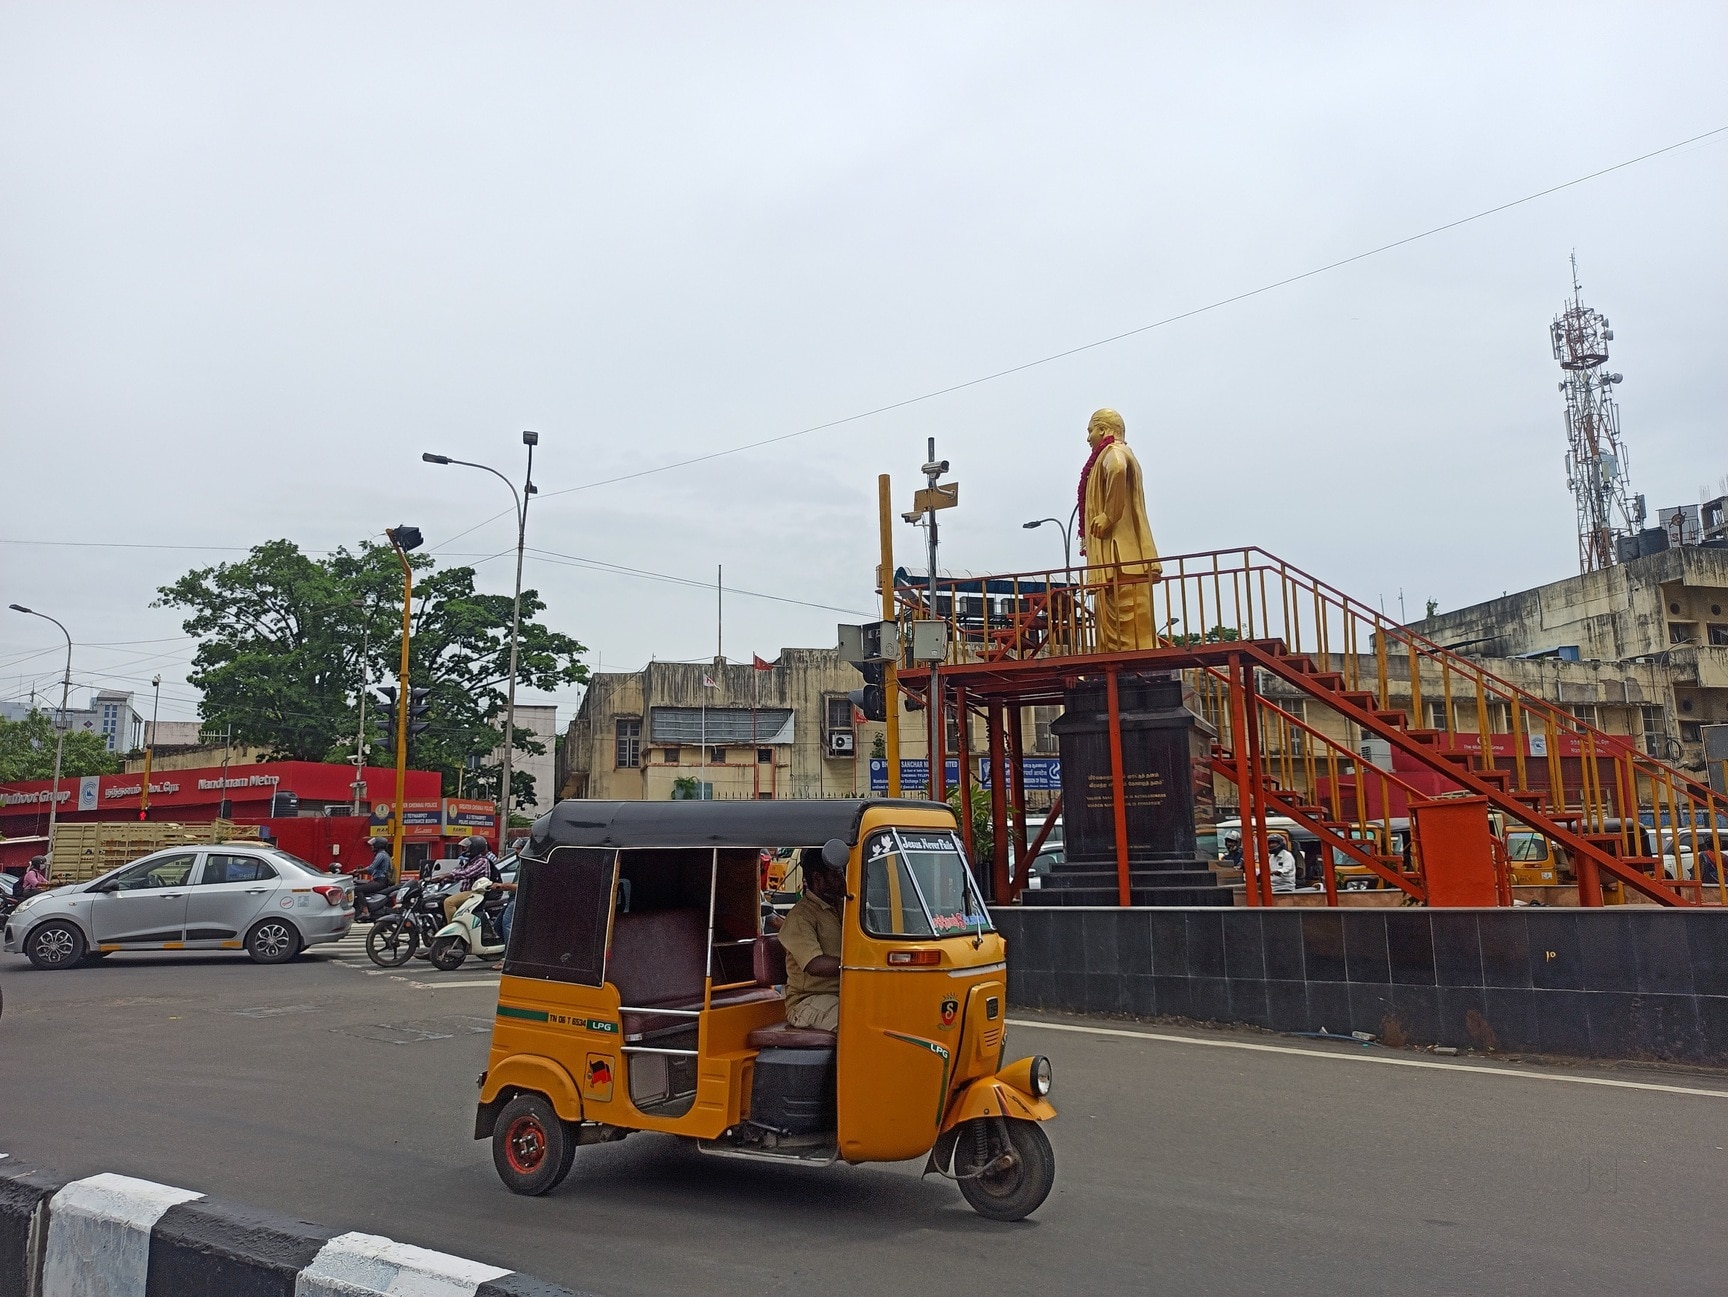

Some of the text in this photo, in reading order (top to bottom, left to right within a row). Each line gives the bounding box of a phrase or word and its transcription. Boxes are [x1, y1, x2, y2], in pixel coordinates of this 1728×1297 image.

[198, 775, 280, 790] Nandanam Metro
[40, 789, 71, 804] Grup
[901, 836, 922, 849] Jesus
[920, 837, 941, 849] Never
[550, 1014, 558, 1022] TN
[567, 1016, 572, 1025] T
[572, 1017, 587, 1027] 6534
[592, 1021, 612, 1031] LPG
[930, 1043, 949, 1059] LPG
